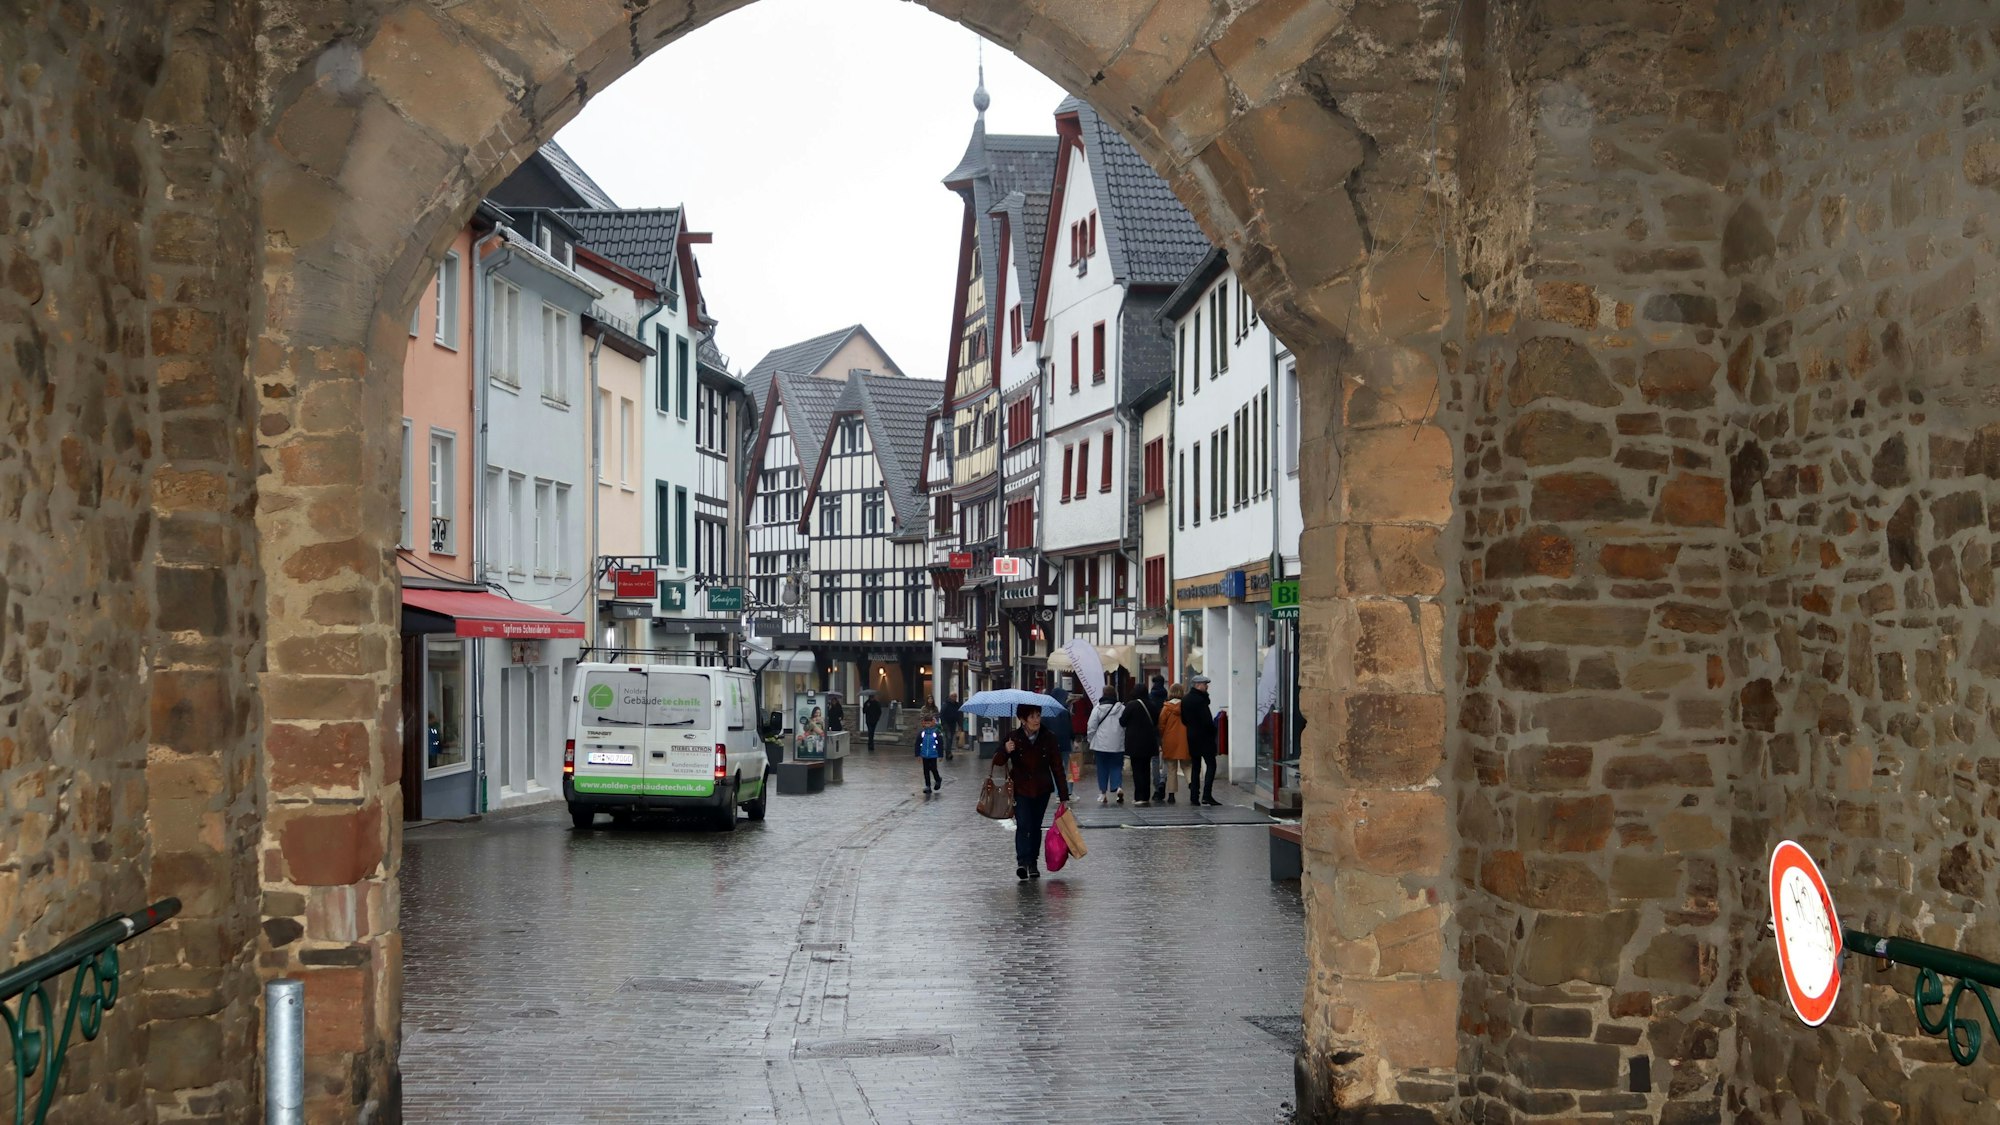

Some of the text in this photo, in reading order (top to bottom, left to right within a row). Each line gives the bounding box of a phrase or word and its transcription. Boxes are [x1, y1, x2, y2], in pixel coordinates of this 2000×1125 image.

[1278, 586, 1299, 603] Bi
[1277, 610, 1299, 618] MAR
[523, 624, 551, 634] Schneiderlein
[623, 696, 701, 707] Gebäudetechnik
[580, 781, 706, 792] www.nolden-gebäudetechnik.de
